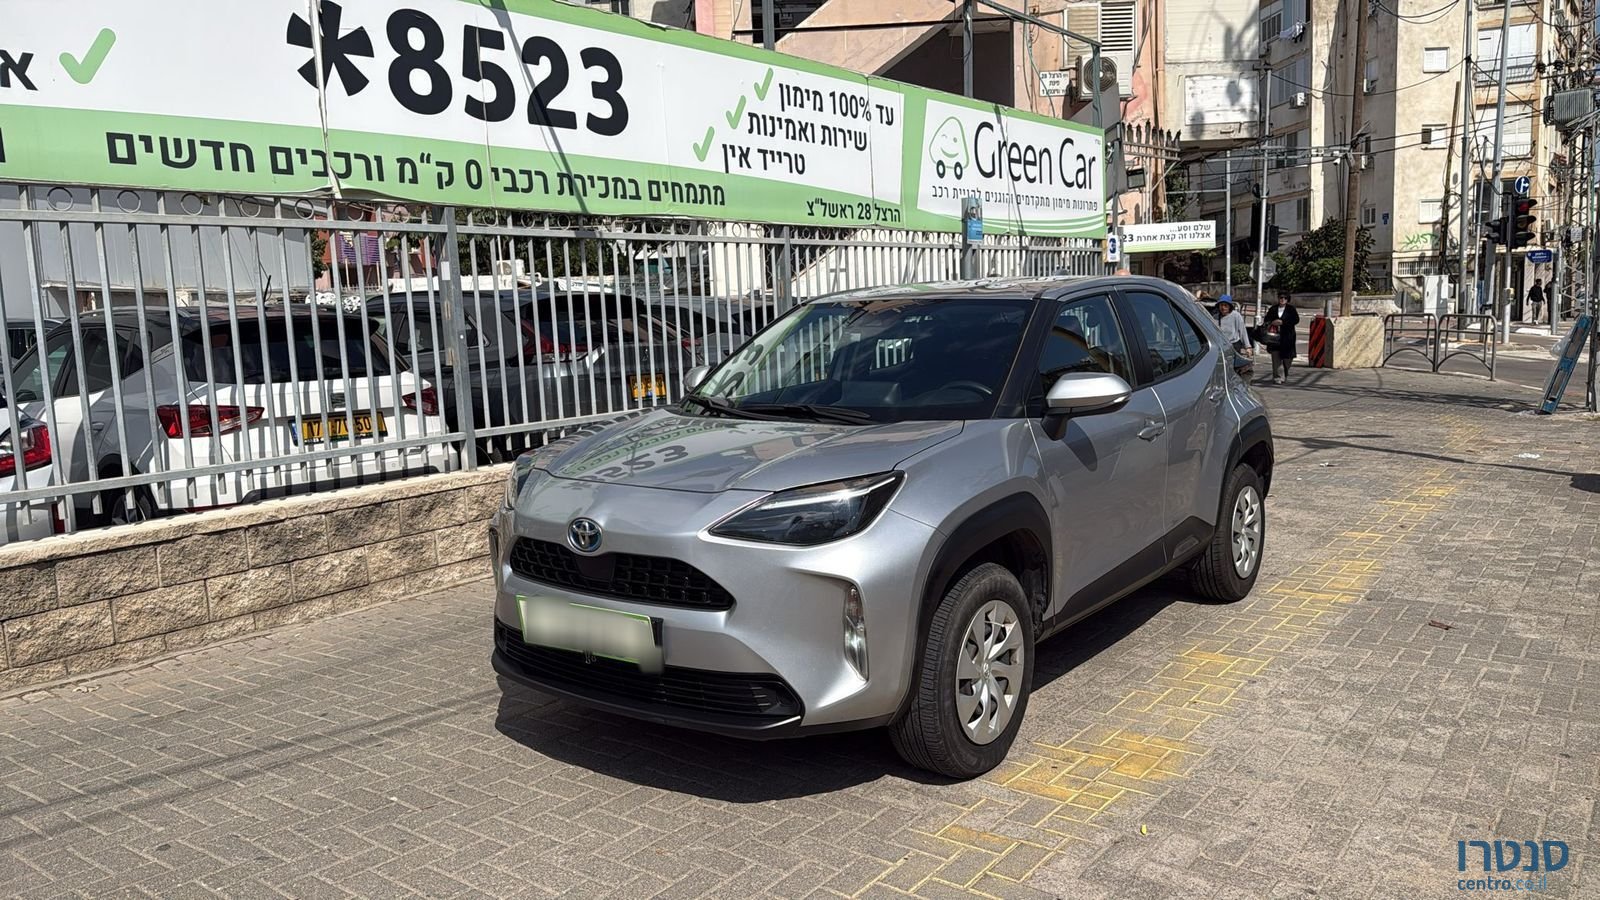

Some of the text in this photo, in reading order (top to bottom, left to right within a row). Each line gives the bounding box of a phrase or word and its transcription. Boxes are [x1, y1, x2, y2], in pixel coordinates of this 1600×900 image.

[778, 83, 894, 126] עד 100% מימון
[748, 111, 867, 151] שירות ואמינות
[106, 131, 255, 173] חדשים
[269, 145, 385, 182] ורכבים
[722, 143, 806, 175] טרייד אין
[974, 121, 1096, 190] Green Car
[465, 159, 483, 190] 0
[492, 166, 547, 195] רכבי
[557, 171, 642, 201] במכירת
[647, 180, 726, 206] מתמחים
[931, 185, 949, 198] רכב
[1016, 193, 1050, 210] מתקדמים
[1052, 196, 1071, 211] מימון
[1072, 198, 1098, 211] פתרונות
[806, 198, 901, 223] הרצל 28 ראשל"צ
[1136, 234, 1158, 243] אחרת
[1159, 233, 1176, 242] קצת
[1193, 223, 1211, 232] שלם
